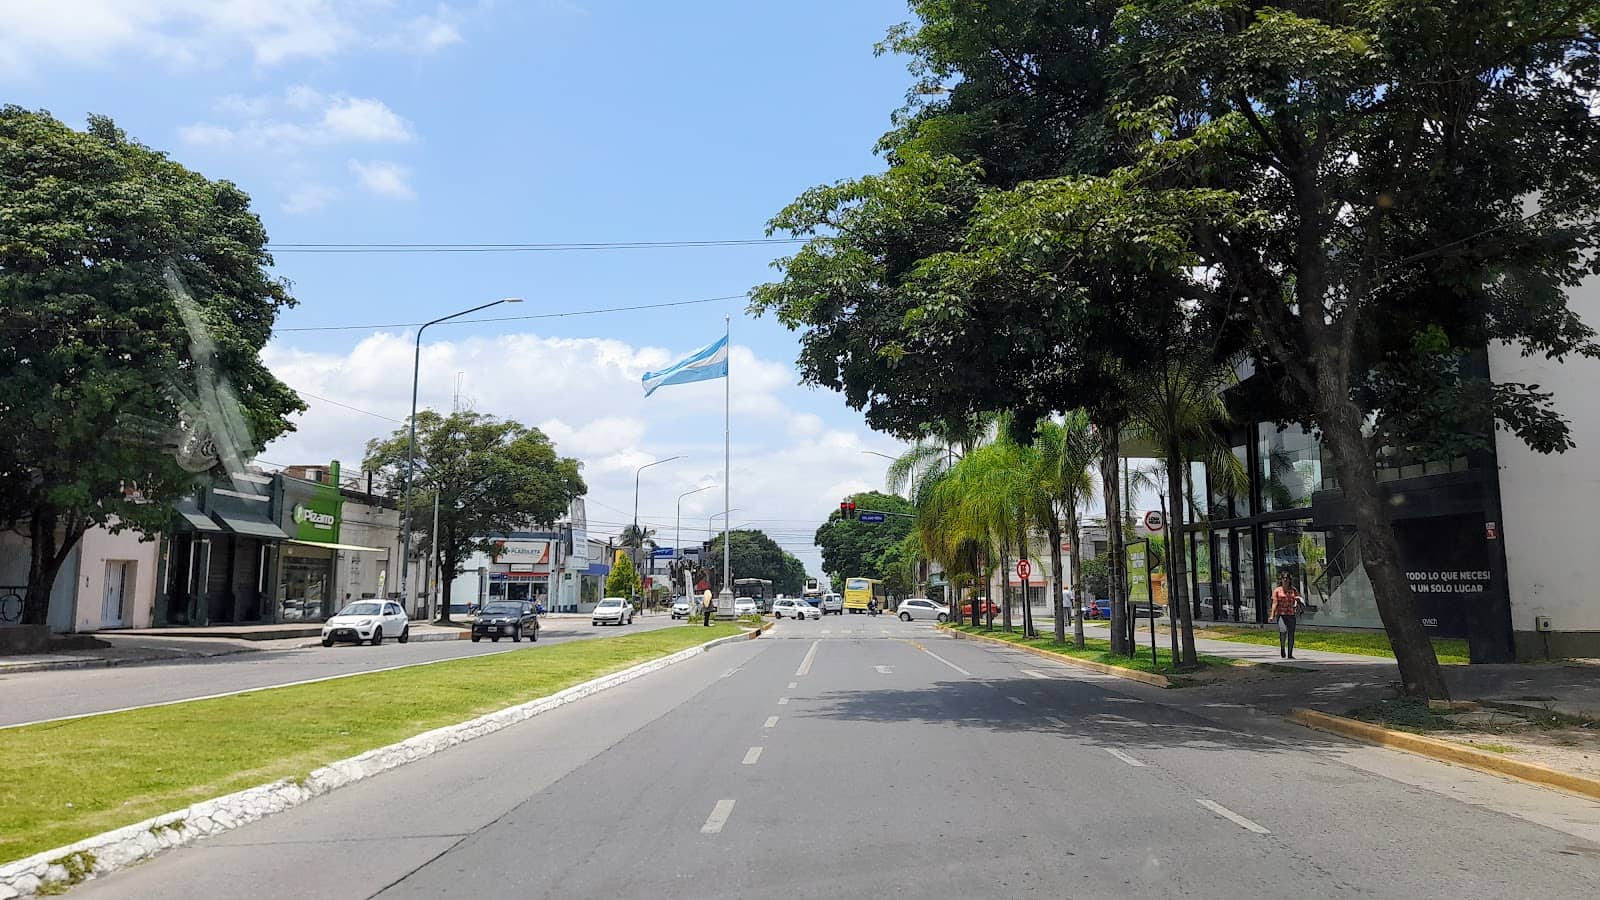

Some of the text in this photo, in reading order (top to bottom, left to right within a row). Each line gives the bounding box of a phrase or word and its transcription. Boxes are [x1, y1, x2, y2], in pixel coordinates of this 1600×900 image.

[304, 508, 334, 525] Pizarro
[1406, 571, 1491, 581] TODO LO QUE NECESI
[1418, 584, 1429, 592] UN
[1431, 584, 1452, 592] SOLO
[1454, 584, 1484, 592] LUGAR
